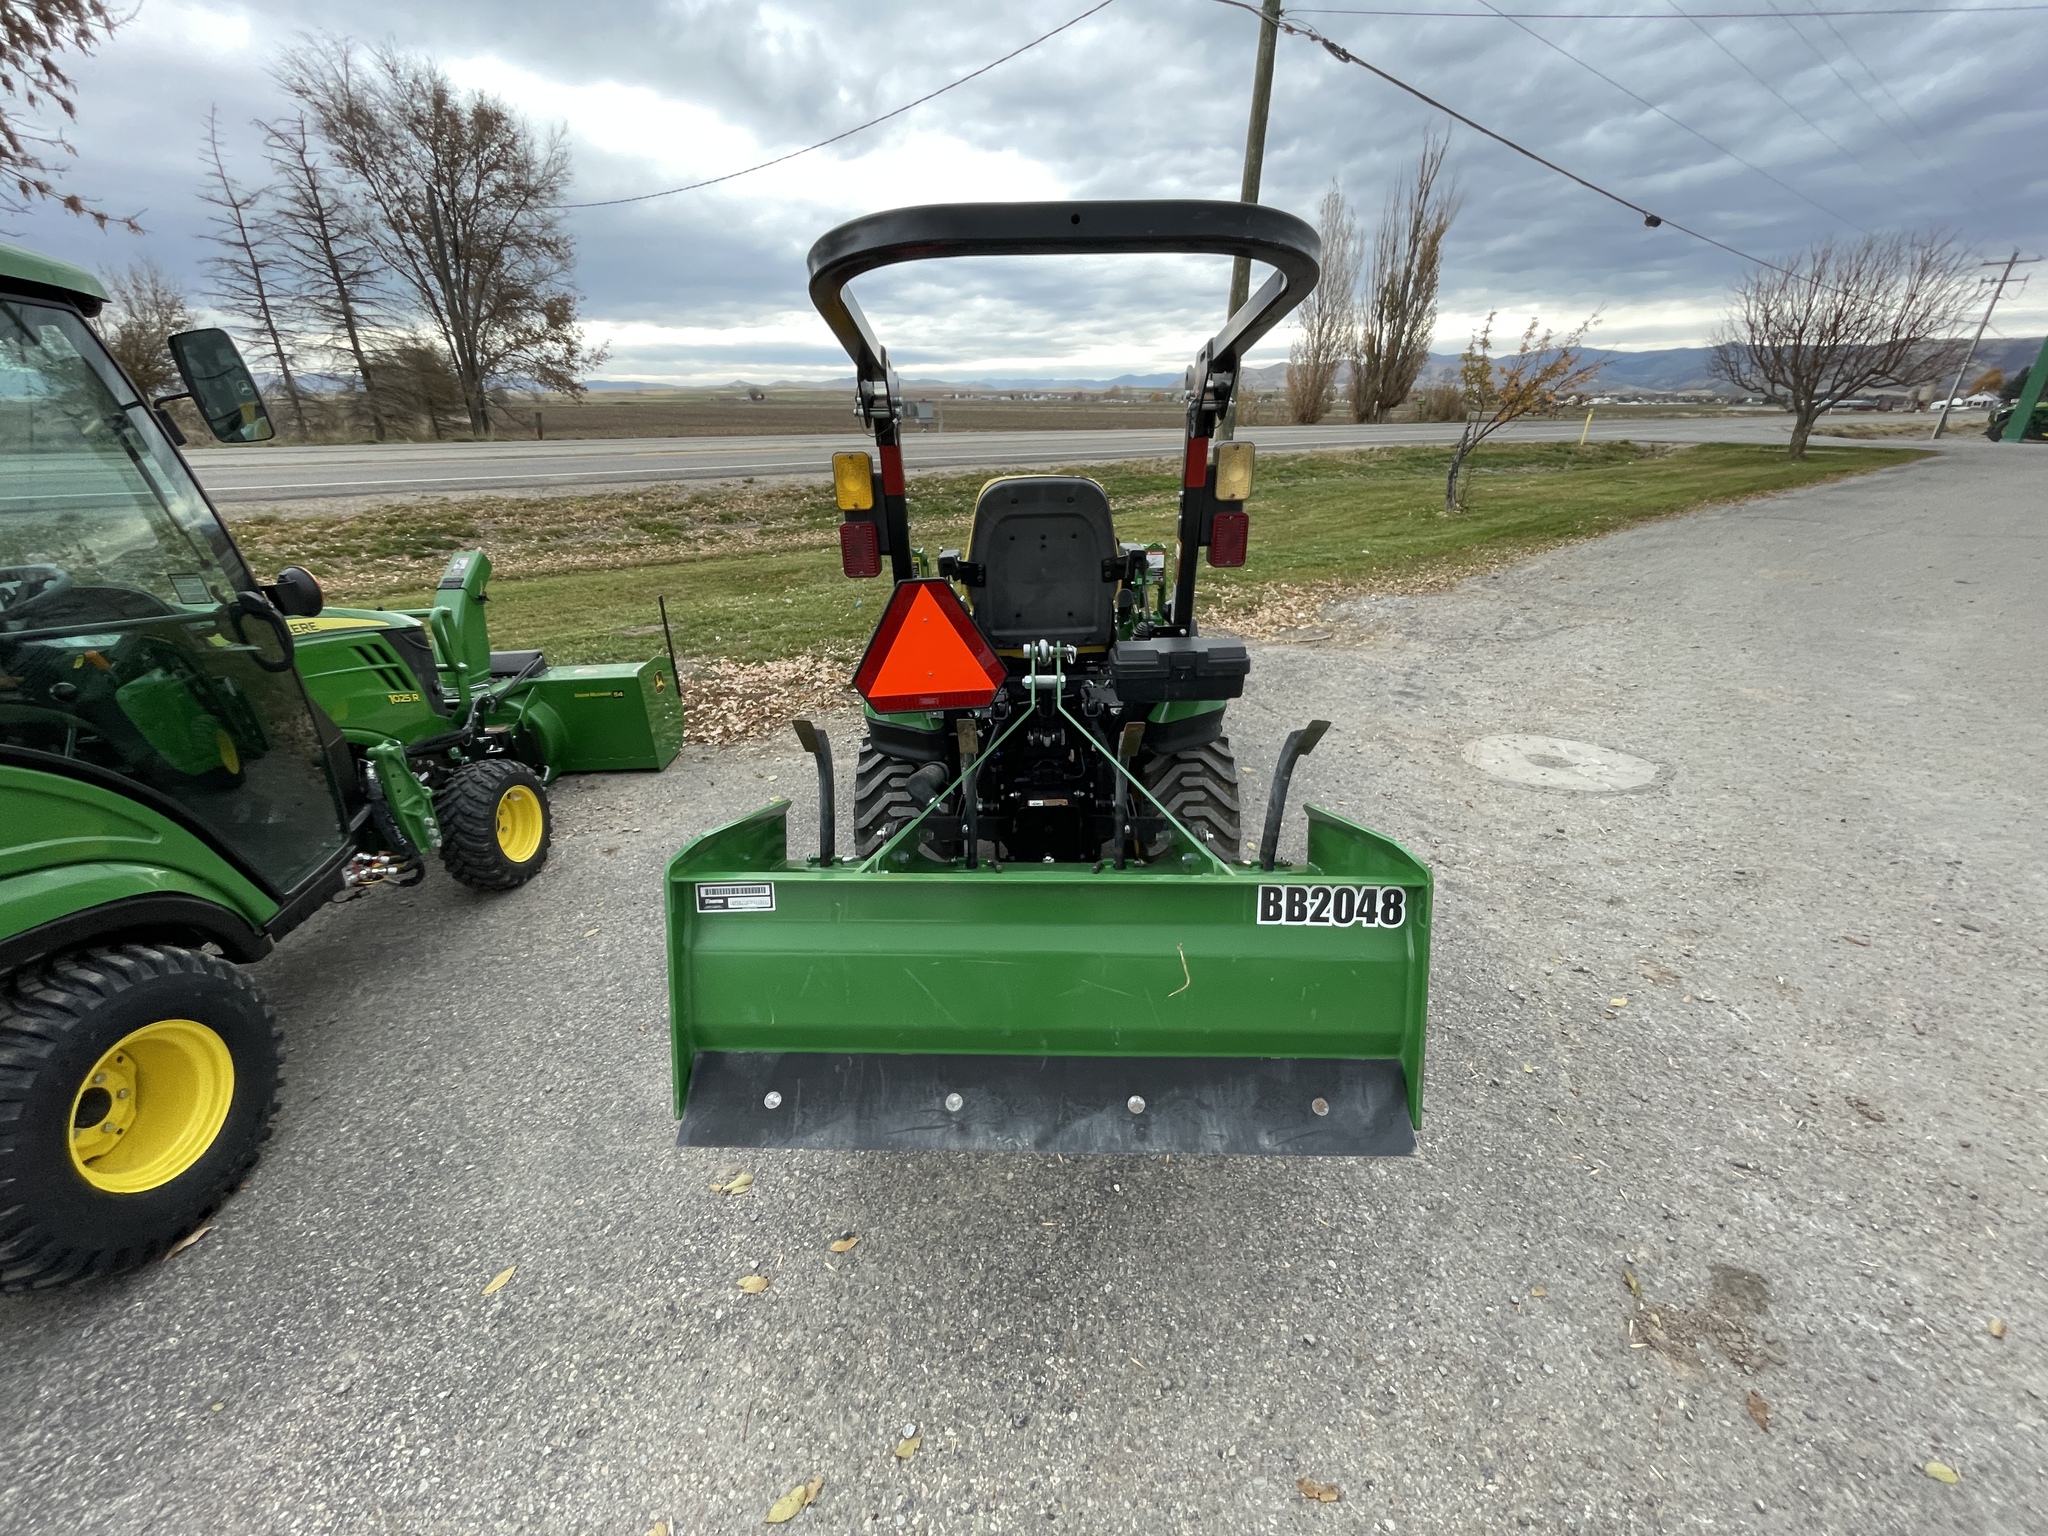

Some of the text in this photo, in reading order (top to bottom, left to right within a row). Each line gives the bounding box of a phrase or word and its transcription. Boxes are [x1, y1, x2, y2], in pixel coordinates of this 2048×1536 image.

[289, 621, 320, 634] ERE
[388, 693, 421, 704] 1025 R
[1260, 886, 1404, 926] BB2048
